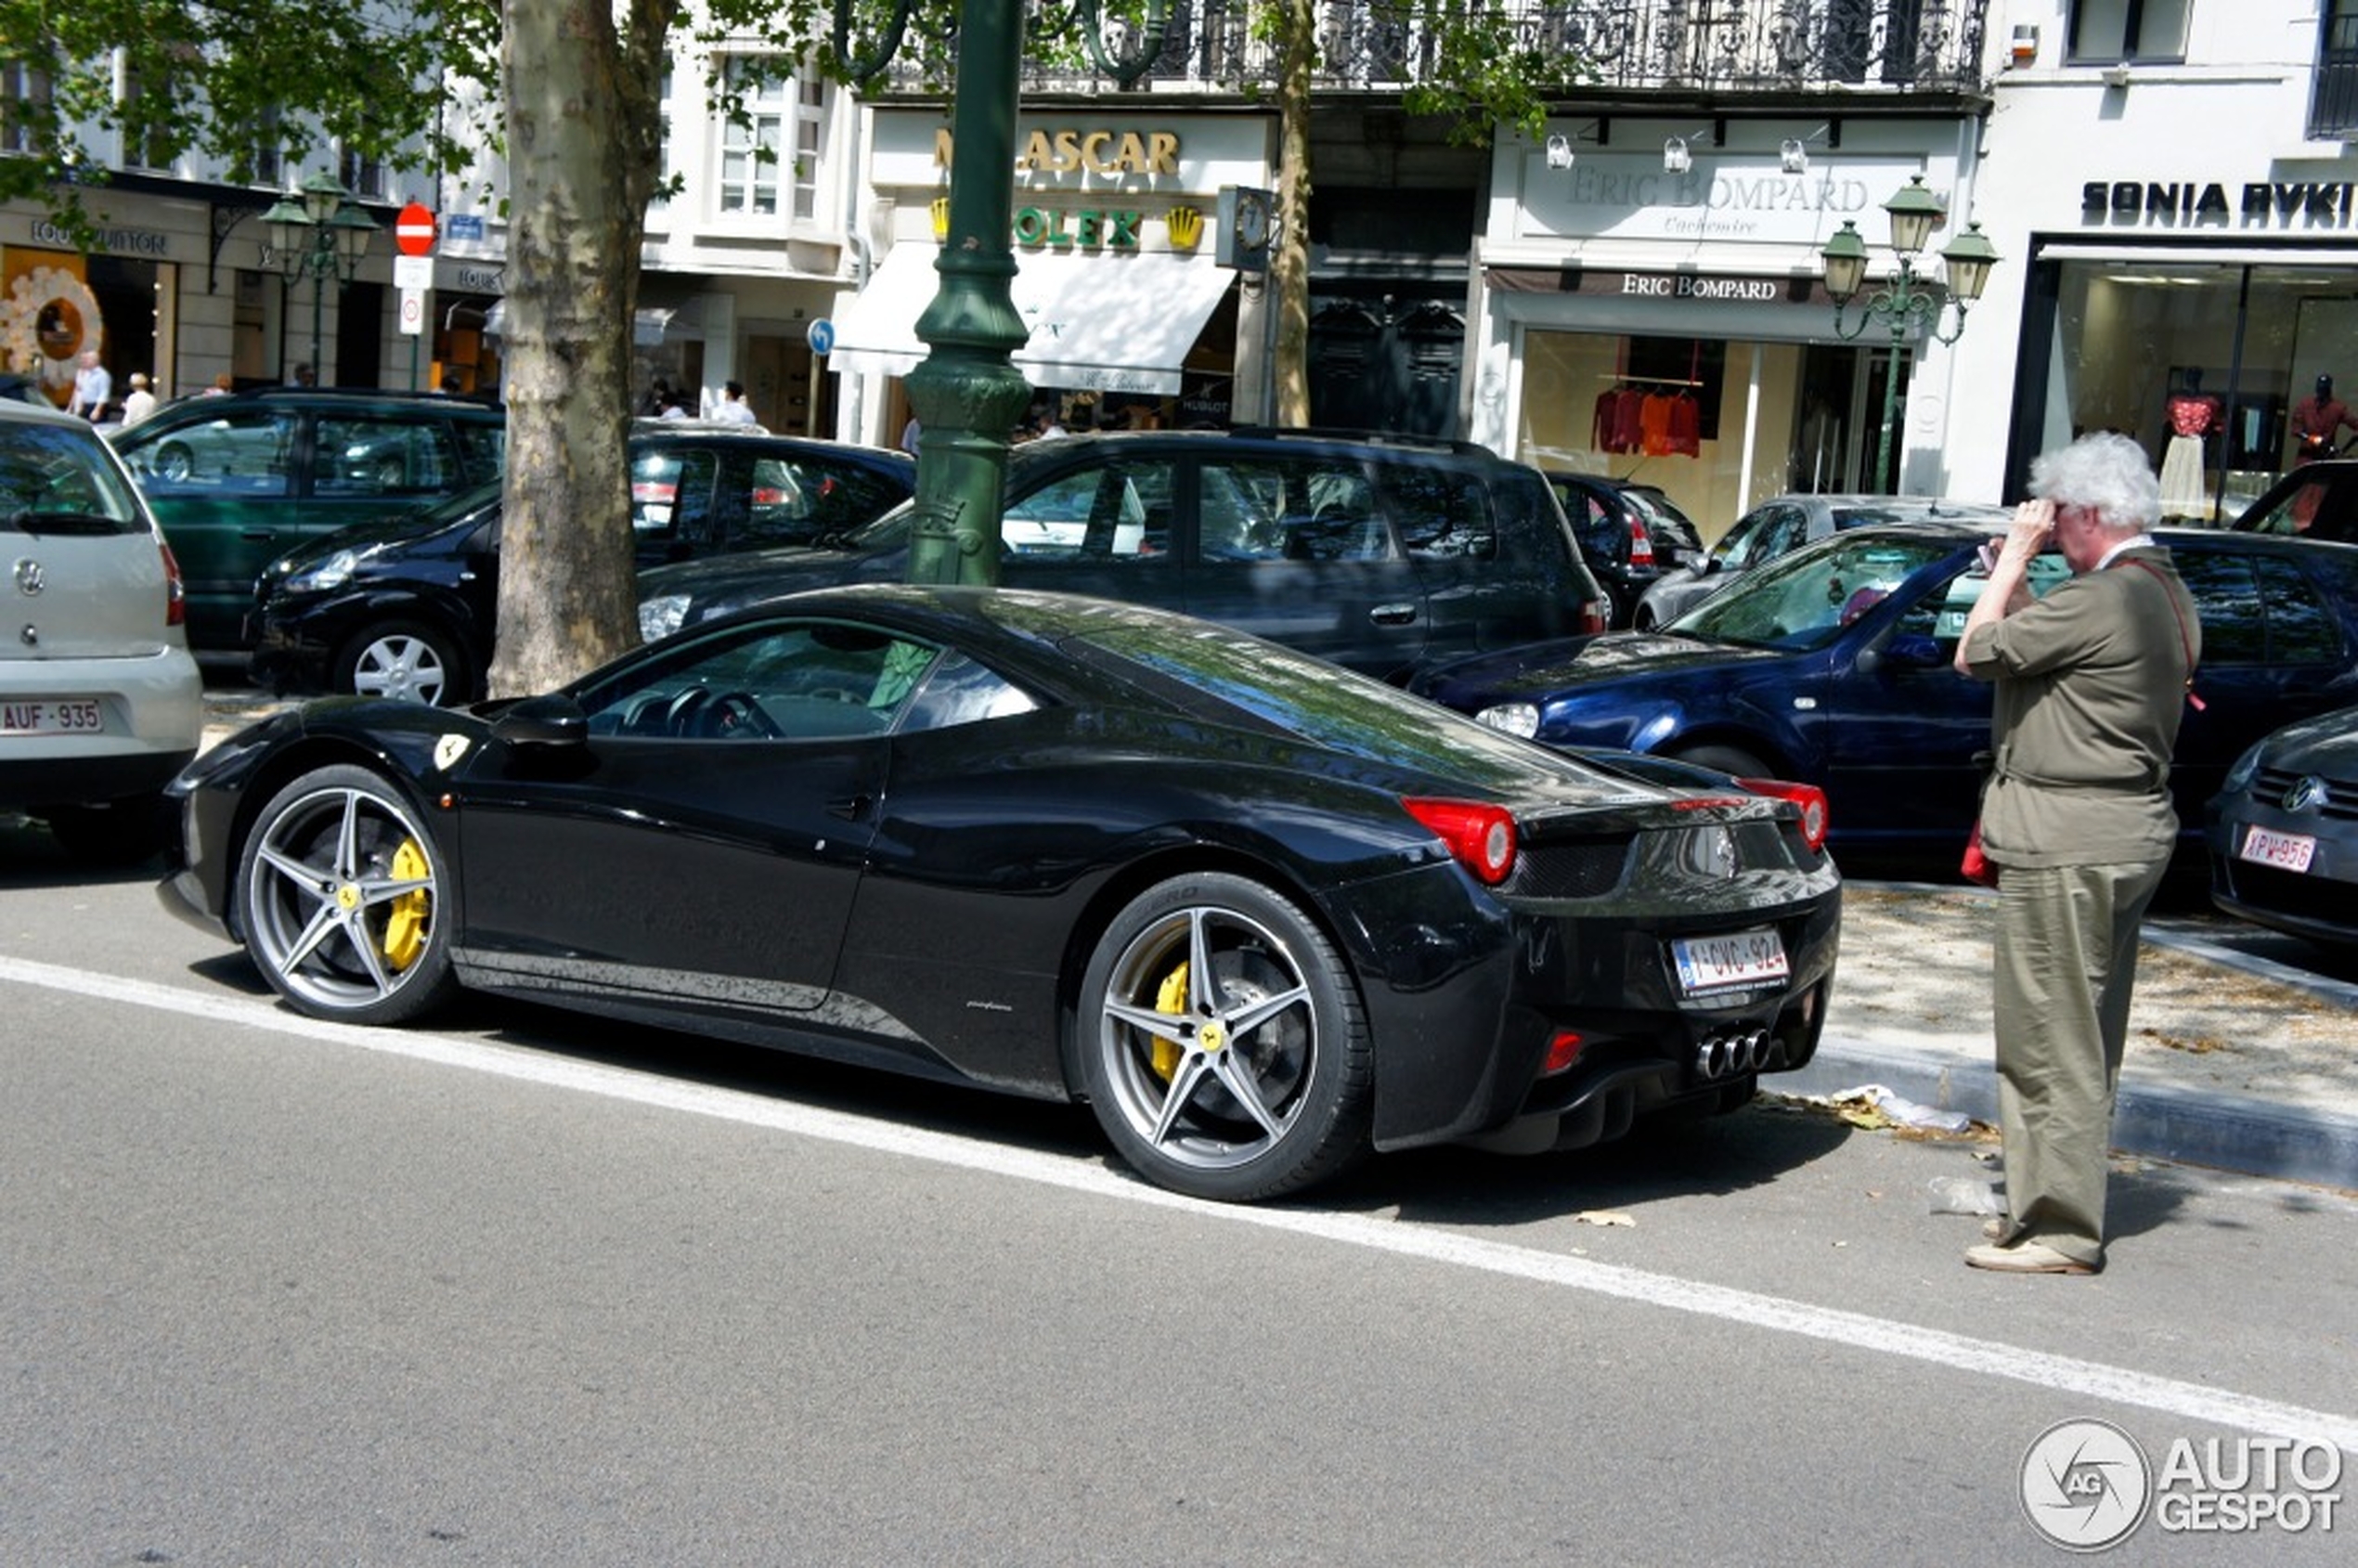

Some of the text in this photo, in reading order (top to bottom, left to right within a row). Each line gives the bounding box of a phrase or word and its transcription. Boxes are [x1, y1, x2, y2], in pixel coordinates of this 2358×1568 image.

[1568, 163, 1869, 213] ERIC BOMPARD
[2081, 182, 2229, 213] SONIA
[1014, 205, 1140, 246] OLEX
[1622, 273, 1777, 301] ERIC BOMPARD
